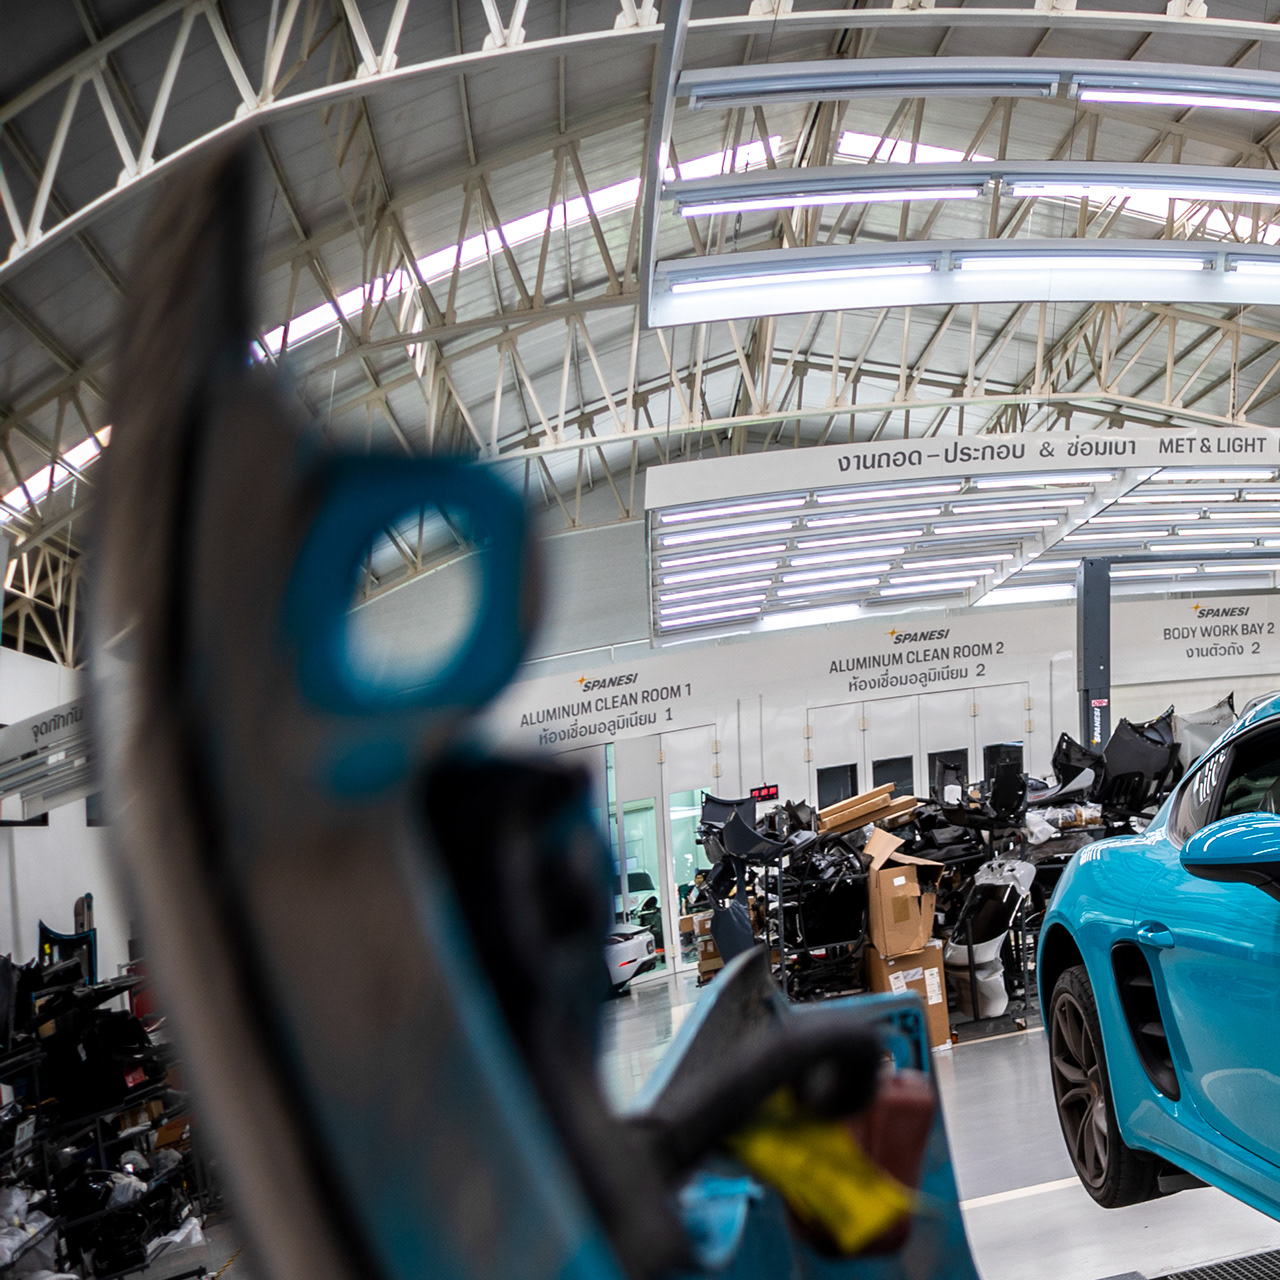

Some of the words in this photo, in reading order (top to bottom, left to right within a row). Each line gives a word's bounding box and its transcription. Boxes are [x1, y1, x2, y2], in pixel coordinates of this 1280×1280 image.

[1039, 441, 1055, 458] &
[1066, 435, 1136, 457] ซ่อมเบา
[1159, 437, 1197, 454] MET
[1199, 437, 1212, 453] &
[1216, 437, 1267, 453] LIGHT
[1197, 607, 1250, 619] SPANESI
[893, 628, 950, 645] SPANESI
[1163, 626, 1198, 640] BODY
[1200, 624, 1239, 638] WORK
[1241, 623, 1265, 635] BAY
[1267, 622, 1275, 634] 2
[829, 652, 903, 674] ALUMINUM
[906, 646, 950, 665] CLEAN
[953, 642, 993, 659] ROOM
[995, 641, 1005, 654] 2
[1186, 641, 1244, 658] งานตัวถัง
[1251, 641, 1261, 654] 2
[581, 673, 639, 693] SPANESI
[848, 664, 969, 692] ห้องเชื่อมอลูมิเนียม
[975, 663, 986, 677] 2
[519, 701, 593, 728] ALUMINUM
[595, 691, 638, 712] CLEAN
[641, 684, 682, 705] ROOM
[684, 683, 692, 696] 1
[538, 711, 657, 747] ห้องเชื่อมอลูมิเนียม
[665, 707, 674, 721] 1
[1093, 707, 1102, 743] SPANESI
